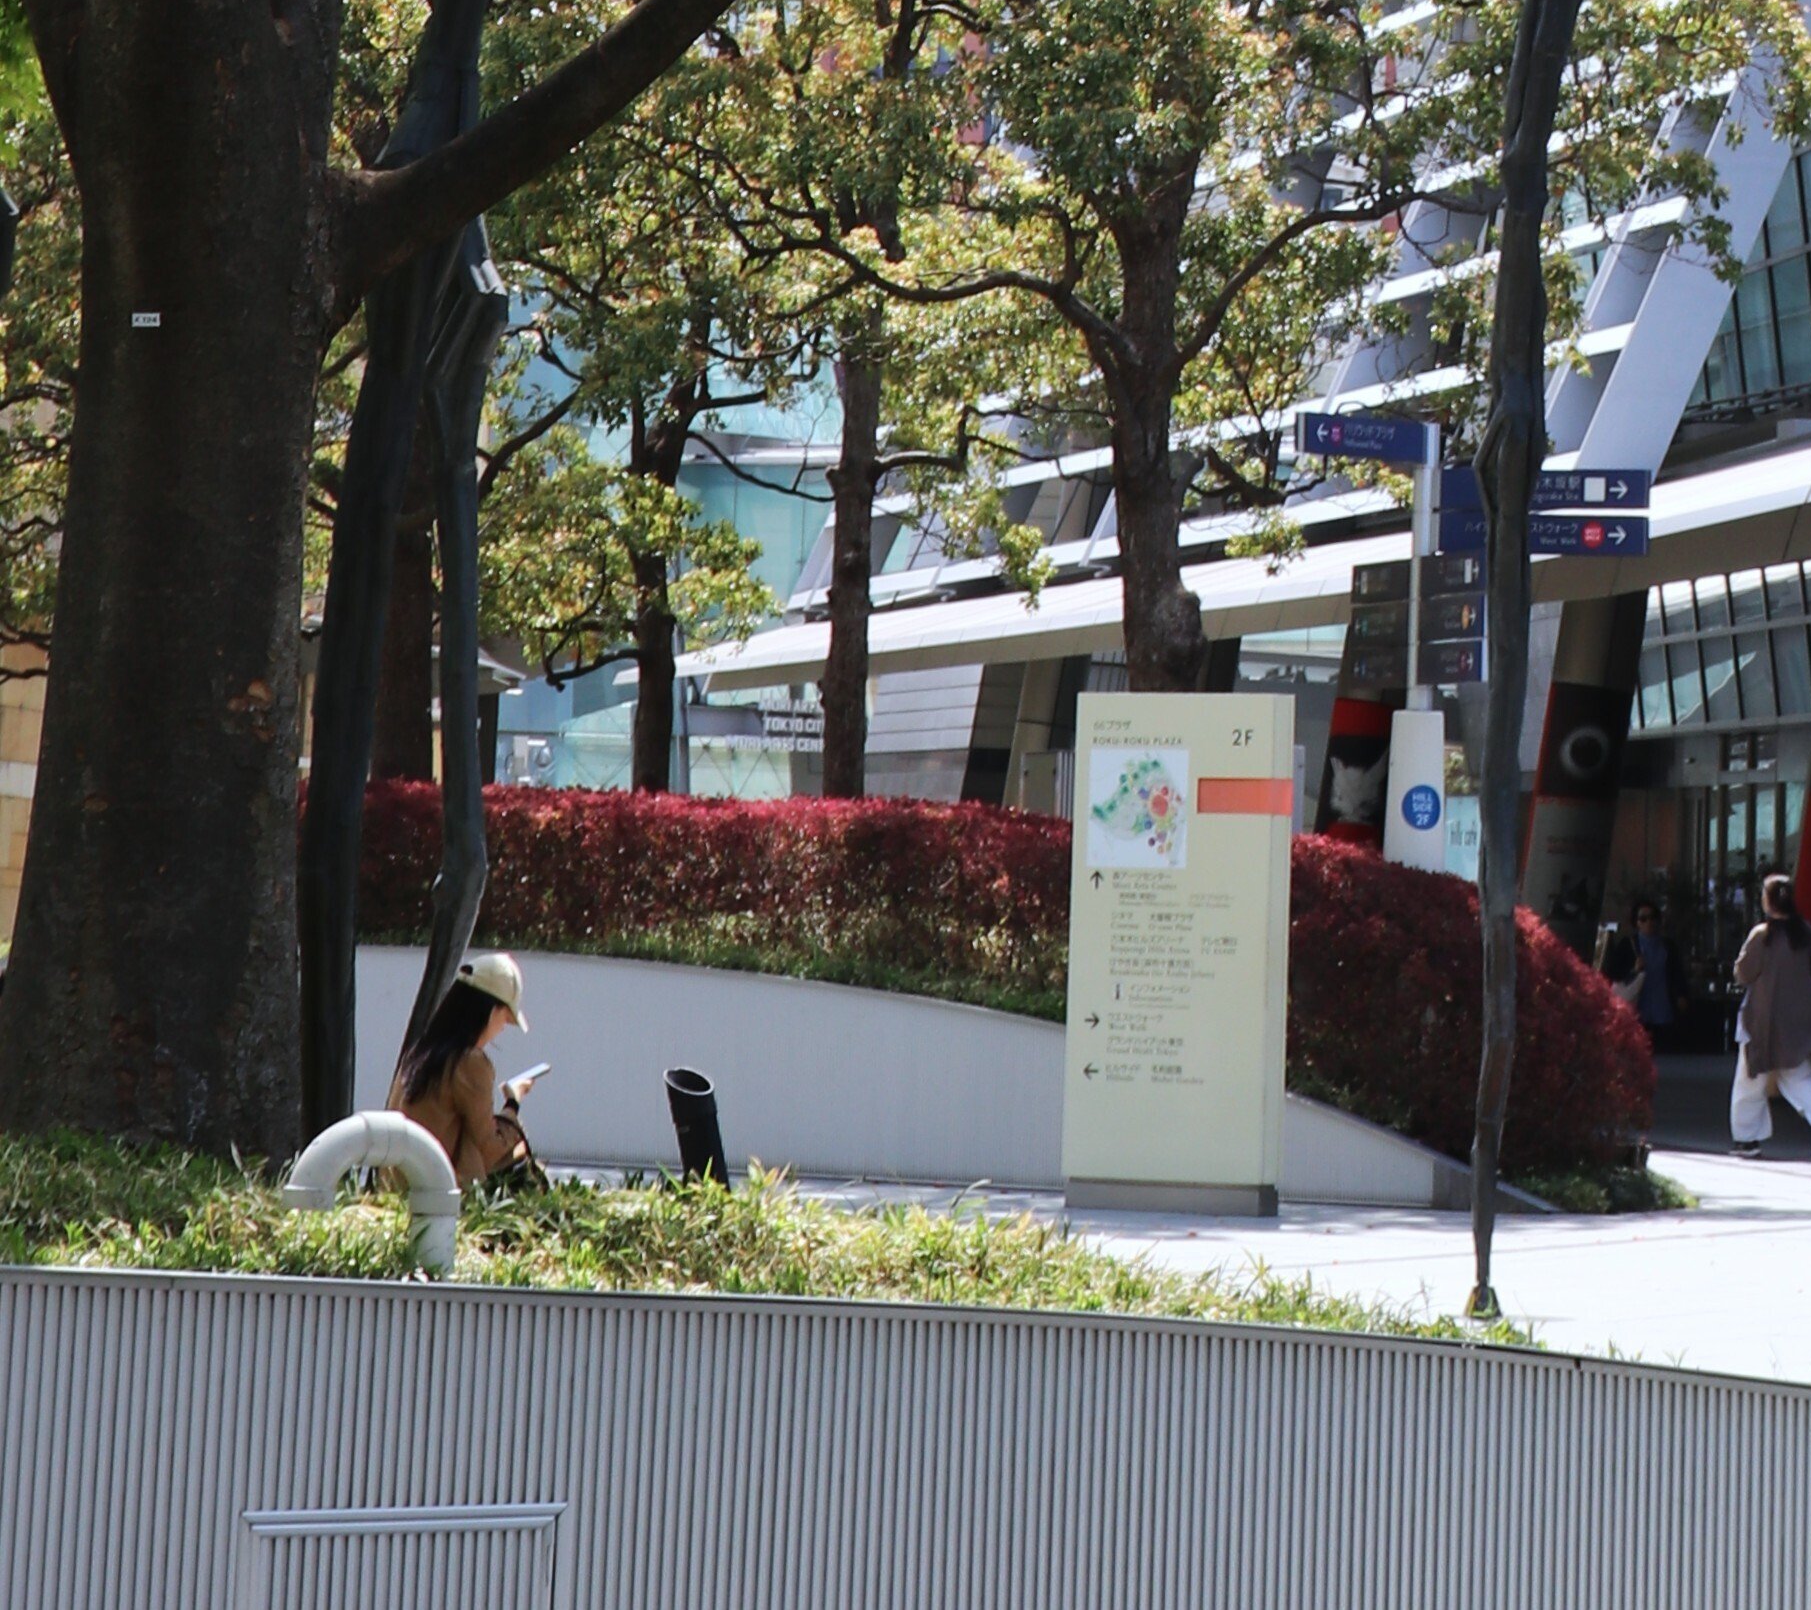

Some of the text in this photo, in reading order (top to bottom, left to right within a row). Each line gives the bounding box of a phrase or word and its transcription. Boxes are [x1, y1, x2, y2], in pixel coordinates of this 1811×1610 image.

[1530, 523, 1578, 534] ストウォーク
[764, 717, 823, 733] TOKYO CIT
[1153, 736, 1183, 746] PLAZA
[1232, 729, 1254, 747] 2F
[797, 738, 824, 752] CENT
[1416, 814, 1430, 826] 2F
